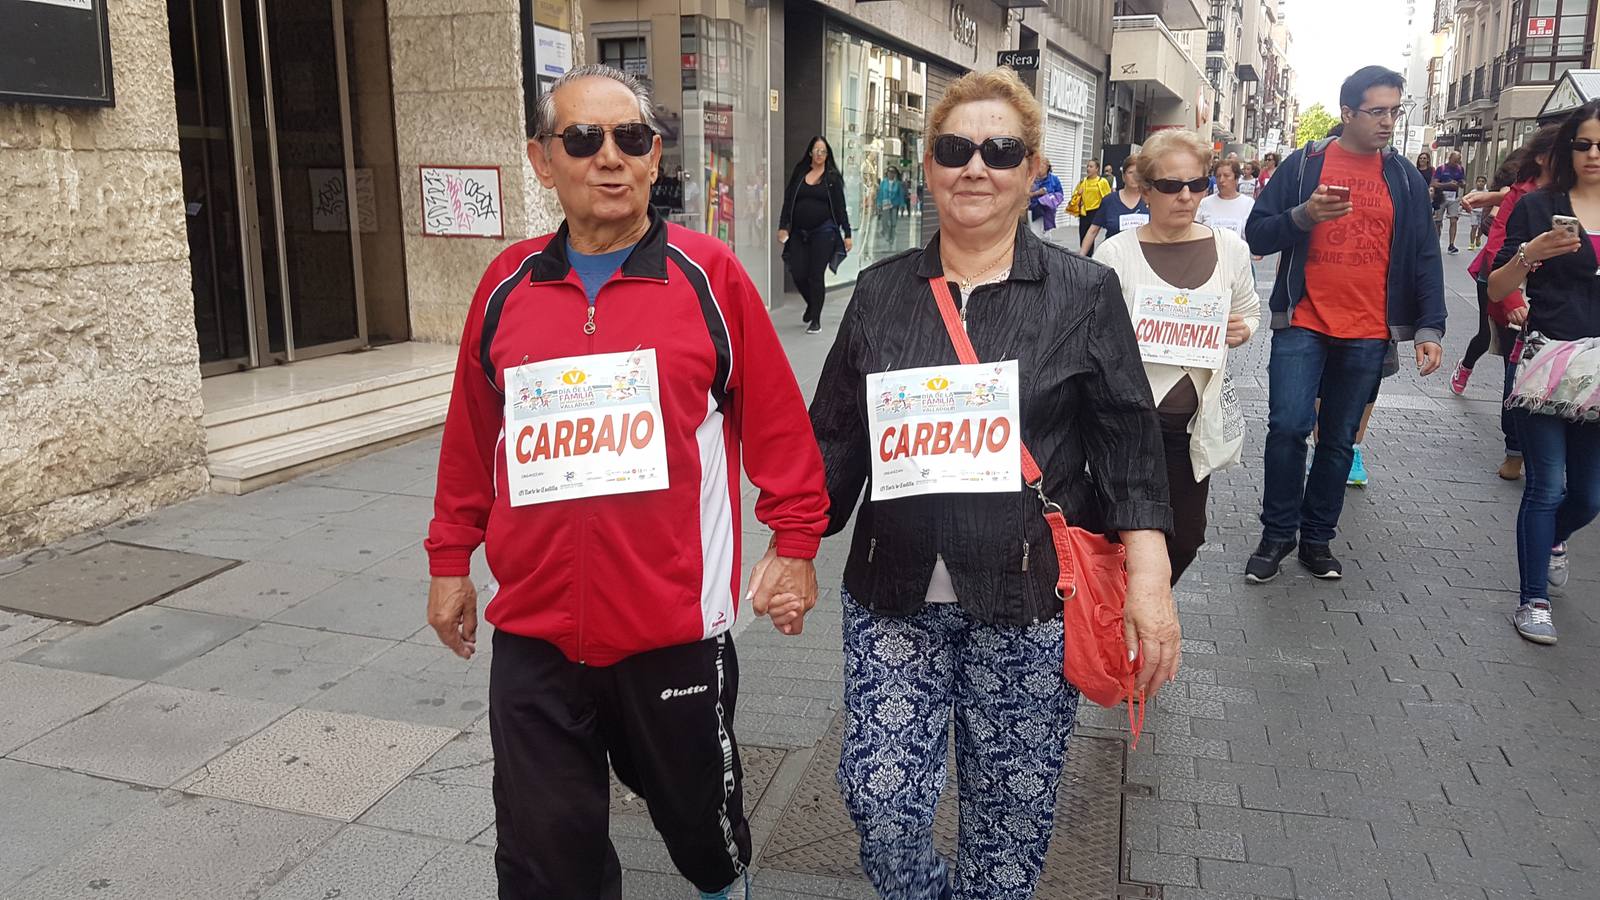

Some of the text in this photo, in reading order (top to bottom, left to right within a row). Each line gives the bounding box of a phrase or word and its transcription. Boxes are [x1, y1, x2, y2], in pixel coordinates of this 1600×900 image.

[1135, 318, 1220, 350] CONTINENTAL
[516, 410, 655, 464] CARBAJO
[879, 416, 1011, 463] CARBAJO
[673, 685, 708, 697] lotto
